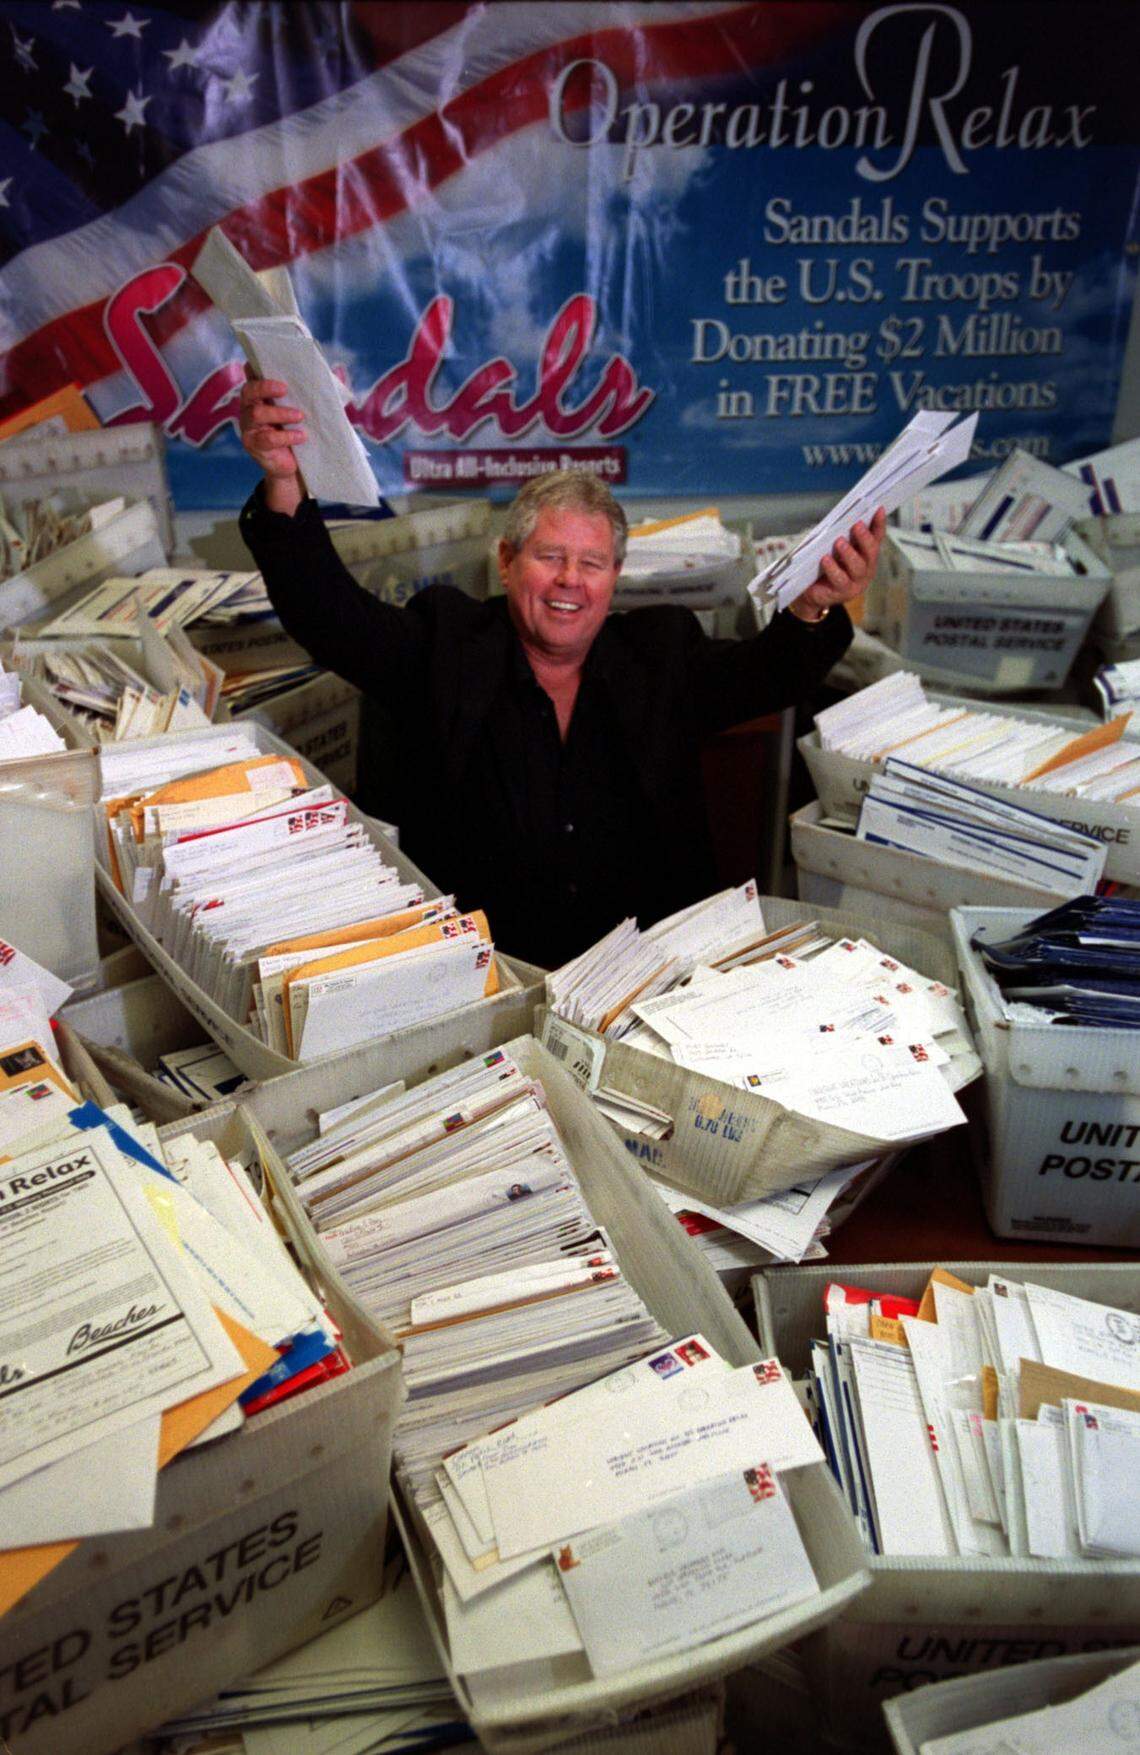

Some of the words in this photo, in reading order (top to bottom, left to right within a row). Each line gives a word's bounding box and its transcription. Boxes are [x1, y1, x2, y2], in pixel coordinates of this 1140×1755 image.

[548, 58, 893, 182] Operation
[855, 4, 1097, 182] Relax
[763, 198, 909, 245] Sandals
[919, 199, 1082, 254] Supports
[724, 260, 788, 305] the
[800, 259, 885, 304] U.S.
[896, 259, 1020, 308] Troops
[1028, 256, 1075, 309] by
[691, 318, 868, 370] Donating
[876, 316, 926, 365] $2
[936, 314, 1064, 359] Million
[716, 379, 755, 419] in
[766, 373, 878, 417] FREE
[893, 370, 1058, 411] Vacations
[409, 454, 453, 480] Ultra
[9, 1154, 91, 1196] Relax
[66, 1303, 167, 1356] Beaches
[107, 1509, 299, 1640] STATES
[107, 1531, 324, 1681] SERVICE
